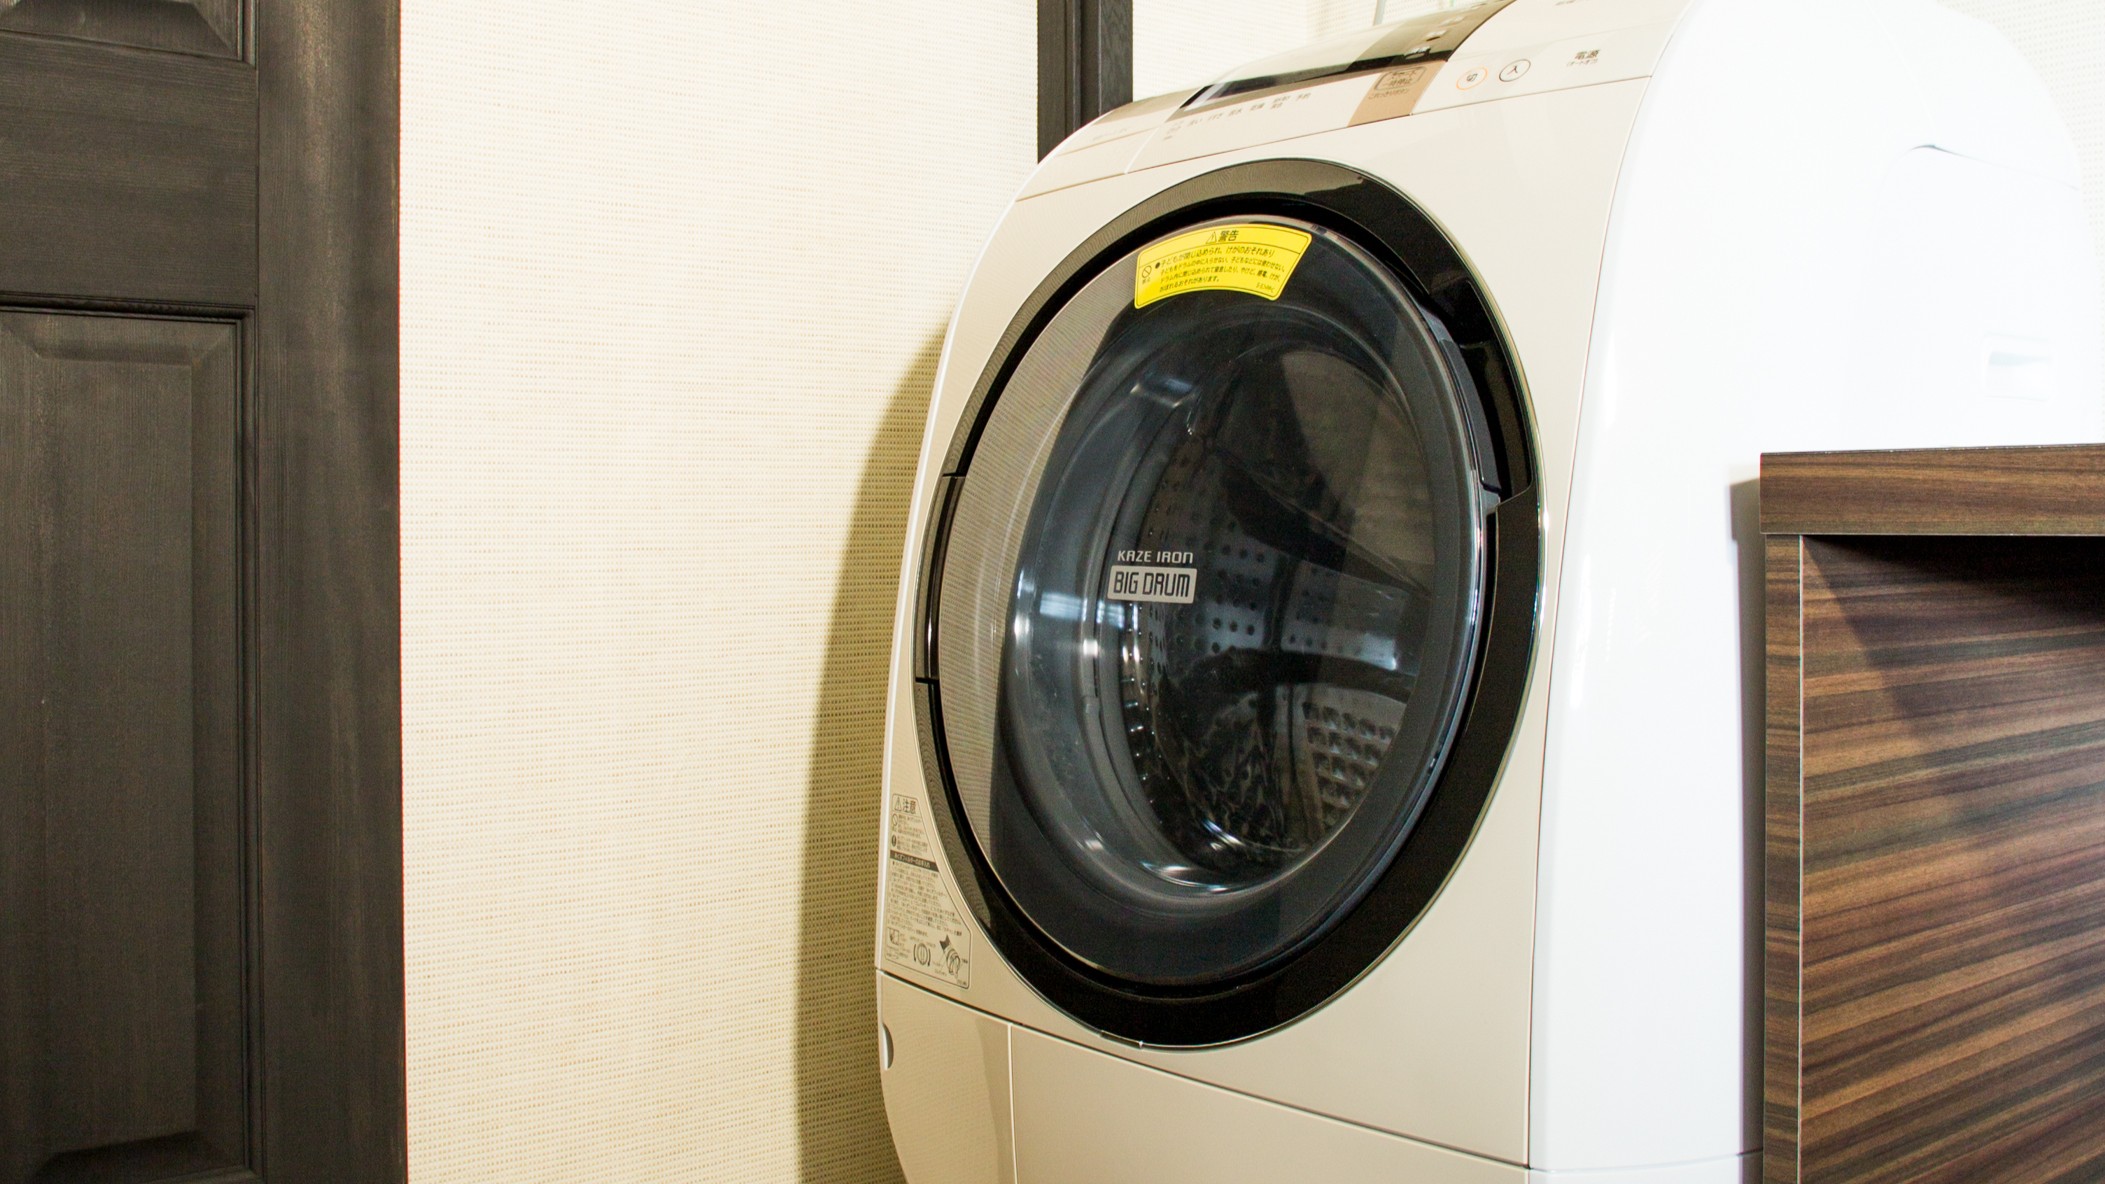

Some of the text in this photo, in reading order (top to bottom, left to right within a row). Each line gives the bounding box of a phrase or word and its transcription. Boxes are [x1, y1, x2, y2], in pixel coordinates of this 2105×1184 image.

[1574, 49, 1601, 60] 電源
[1507, 66, 1518, 75] 入
[1218, 229, 1239, 242] 警告
[1117, 550, 1194, 564] KAZE IRON
[1113, 571, 1190, 598] BIG DRUM
[902, 798, 917, 815] 注意
